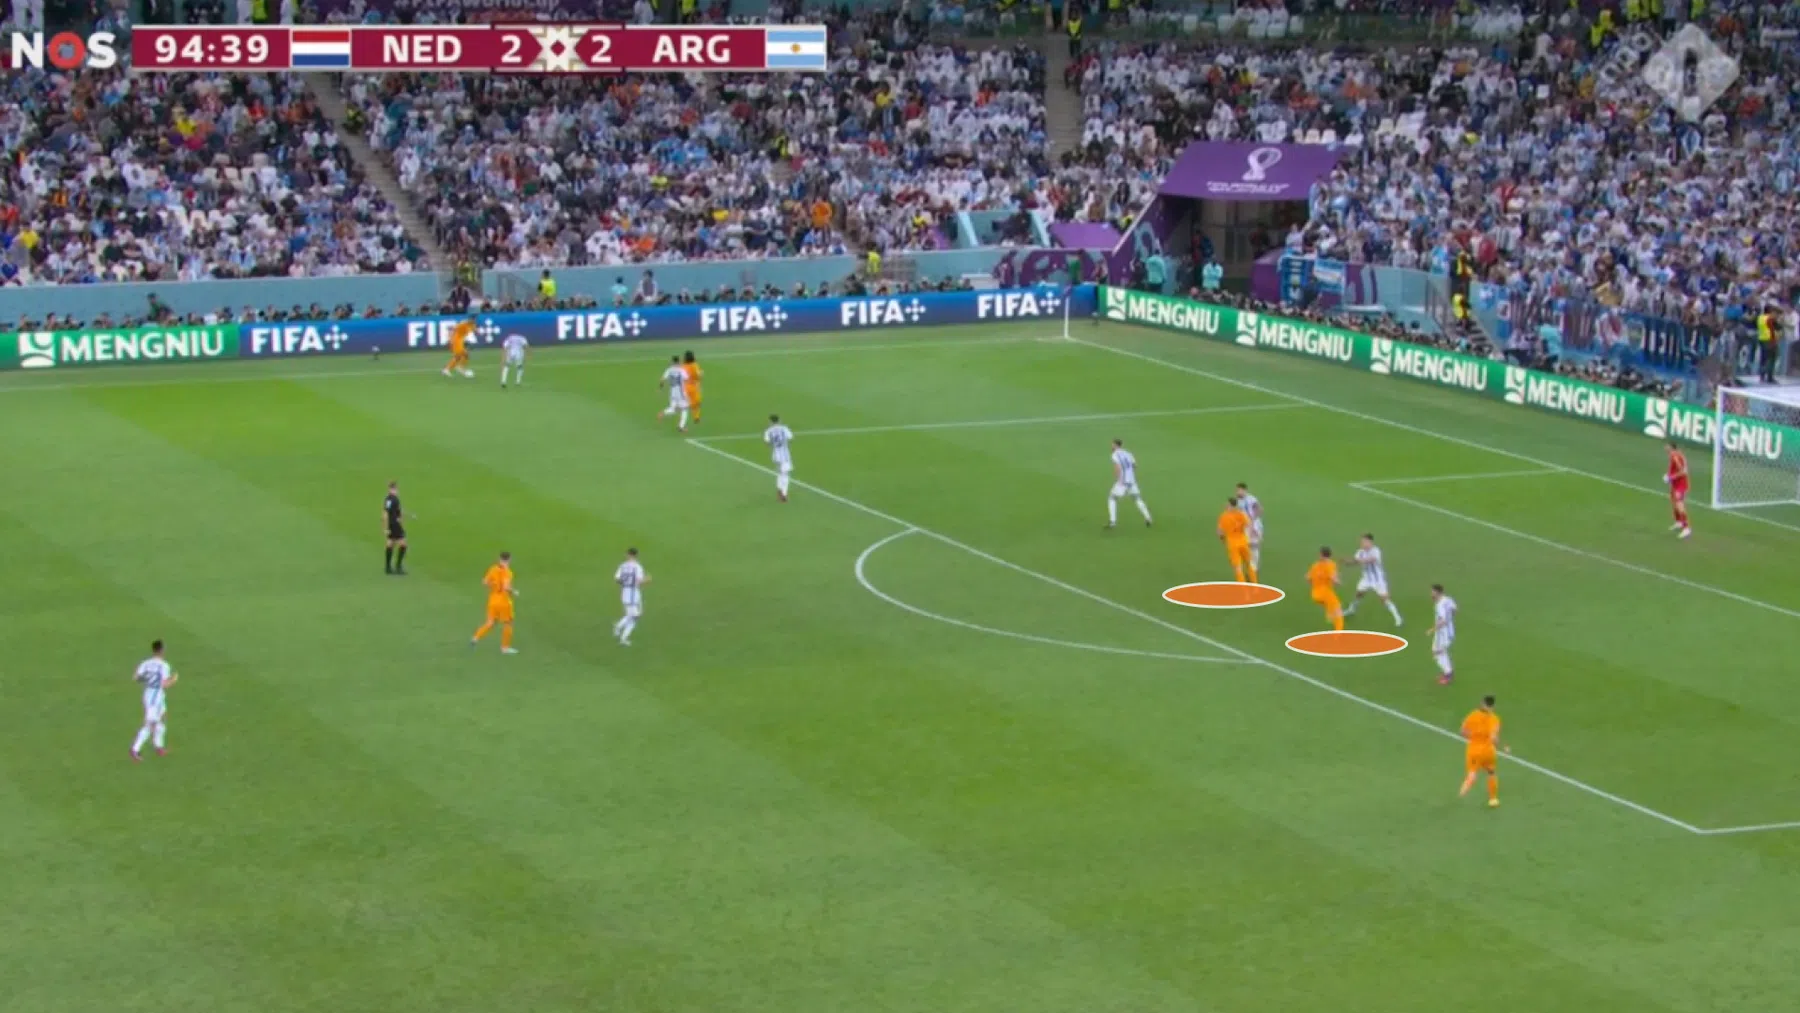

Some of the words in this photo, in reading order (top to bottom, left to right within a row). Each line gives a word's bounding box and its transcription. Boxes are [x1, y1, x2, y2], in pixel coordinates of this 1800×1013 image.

[1128, 296, 1220, 335] MENGNIU
[61, 330, 223, 361] MENGNIU
[1259, 320, 1354, 362] MENGNIU
[1392, 347, 1487, 391] MENGNIU
[1527, 376, 1626, 423] MENGNIU
[1670, 408, 1783, 460] MENGNIU
